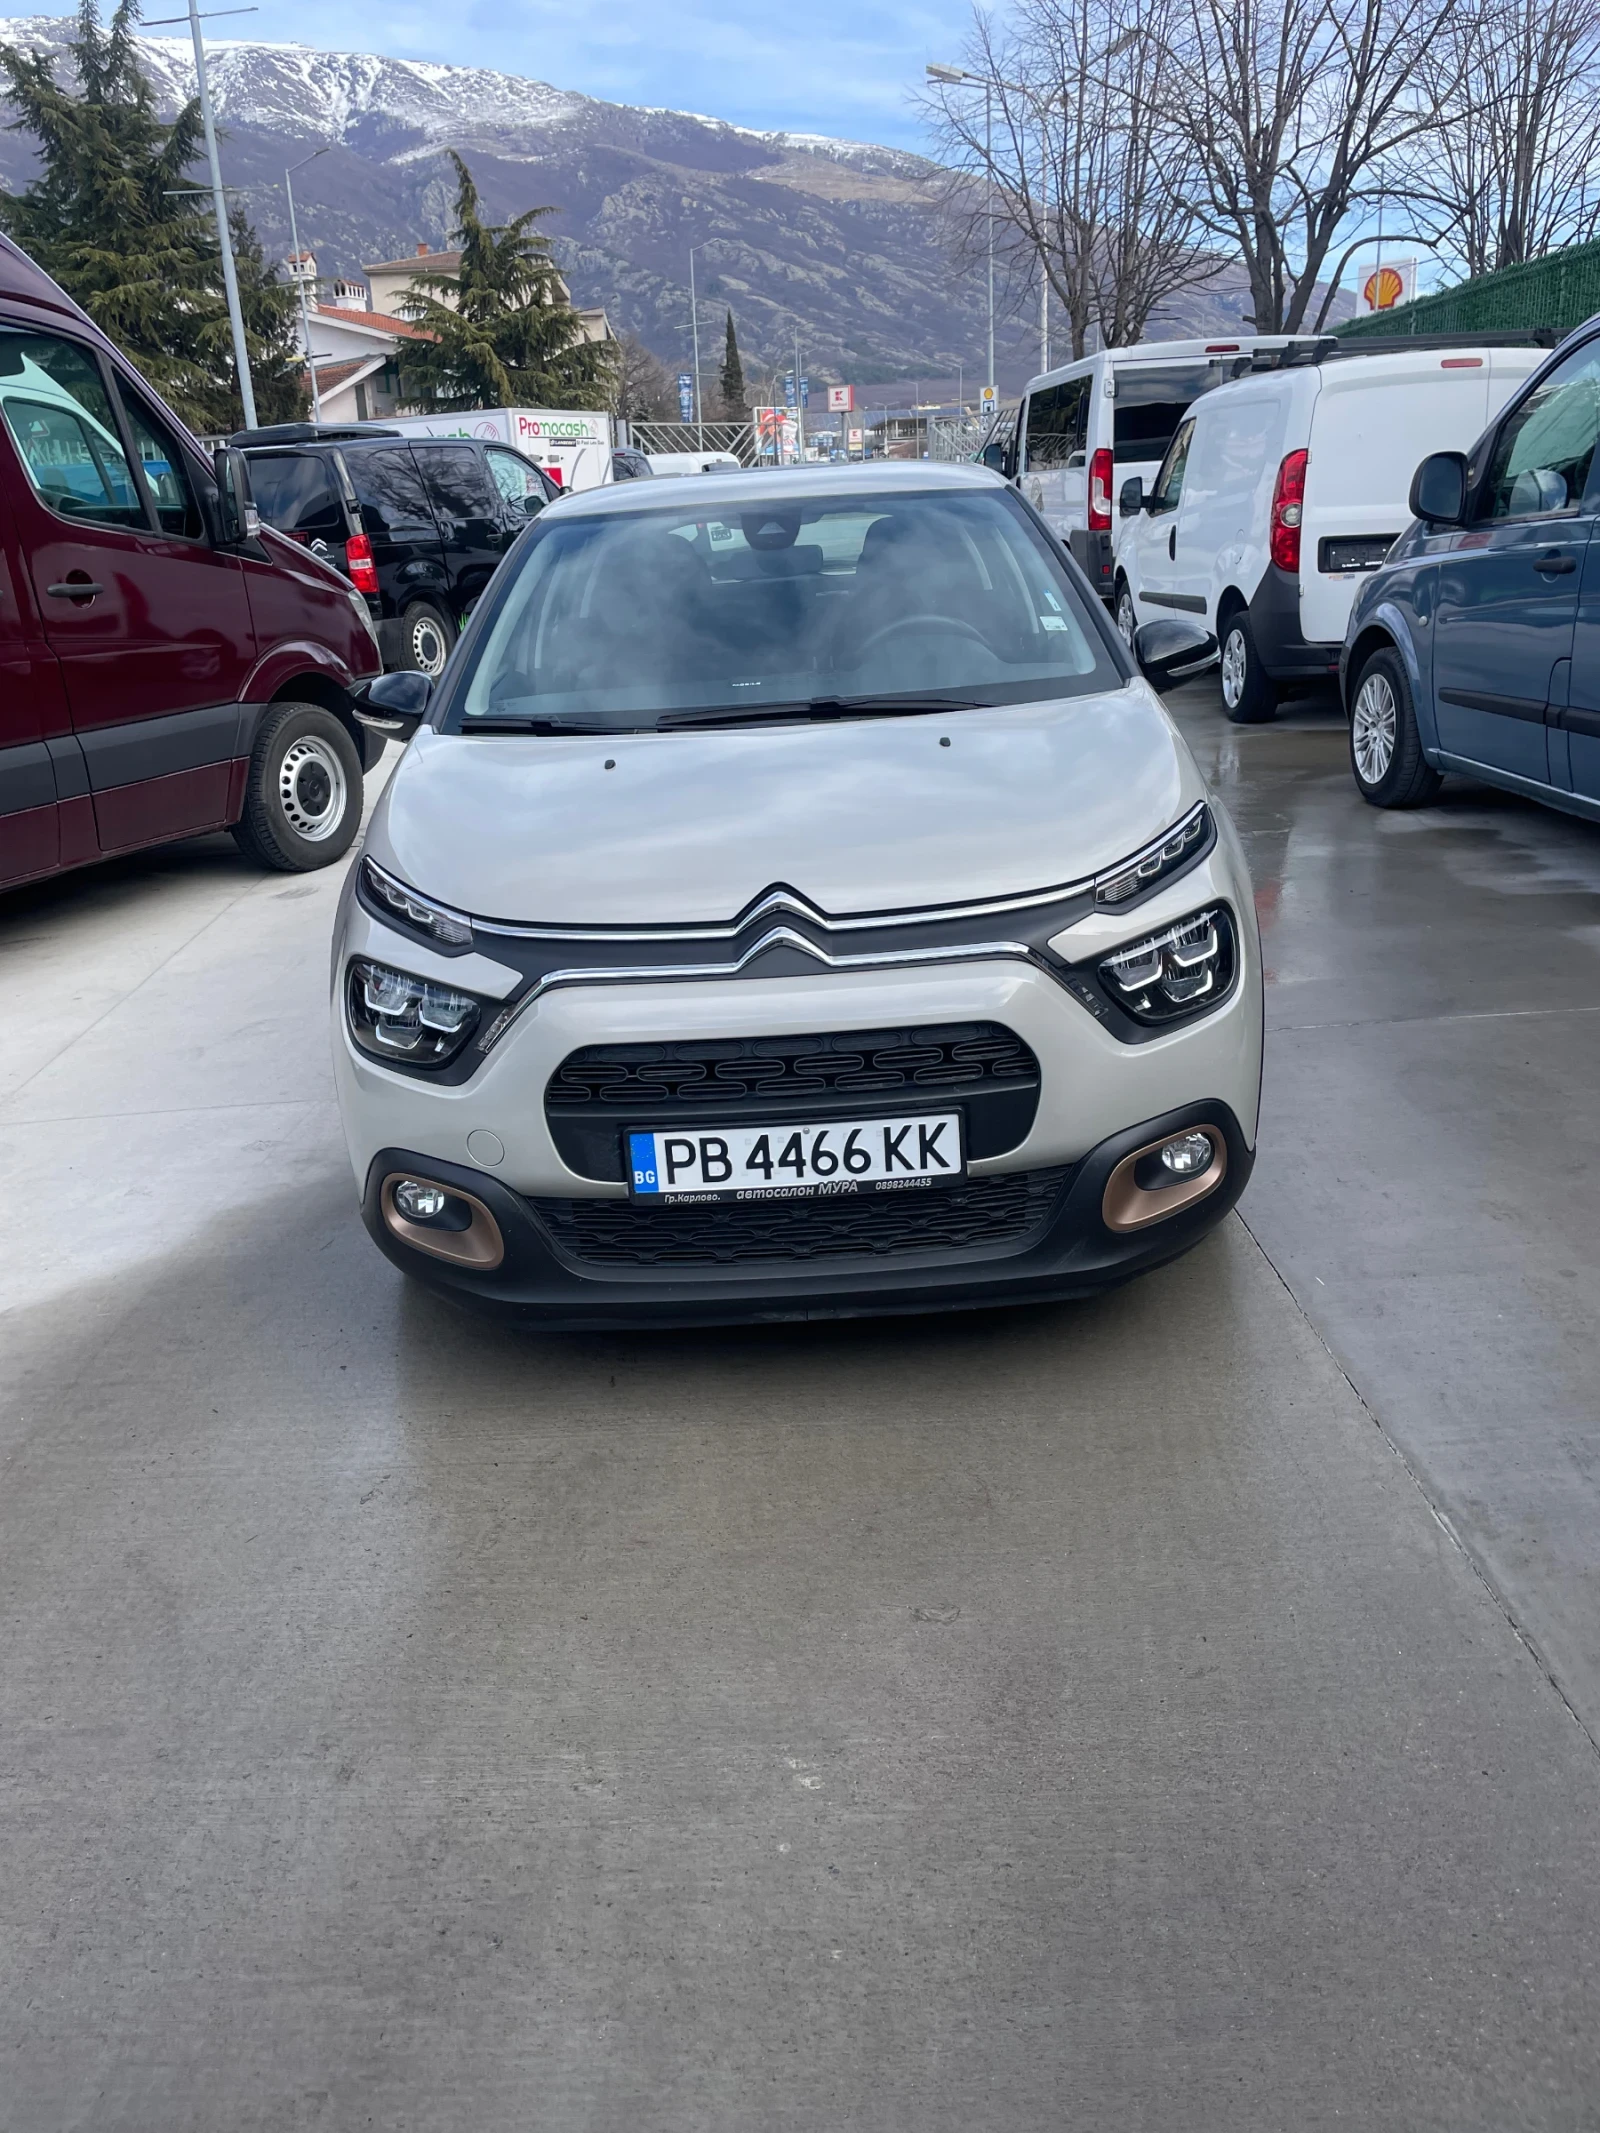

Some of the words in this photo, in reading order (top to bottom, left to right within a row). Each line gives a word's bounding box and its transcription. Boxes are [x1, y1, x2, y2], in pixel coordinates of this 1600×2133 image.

[518, 417, 589, 436] Promocash
[664, 1137, 733, 1185] PB
[745, 1128, 872, 1180] 4466
[883, 1122, 951, 1172] KK
[634, 1171, 656, 1185] BG
[736, 1185, 814, 1199] автосалон
[818, 1181, 858, 1195] МУРА
[875, 1178, 933, 1190] 0898244455
